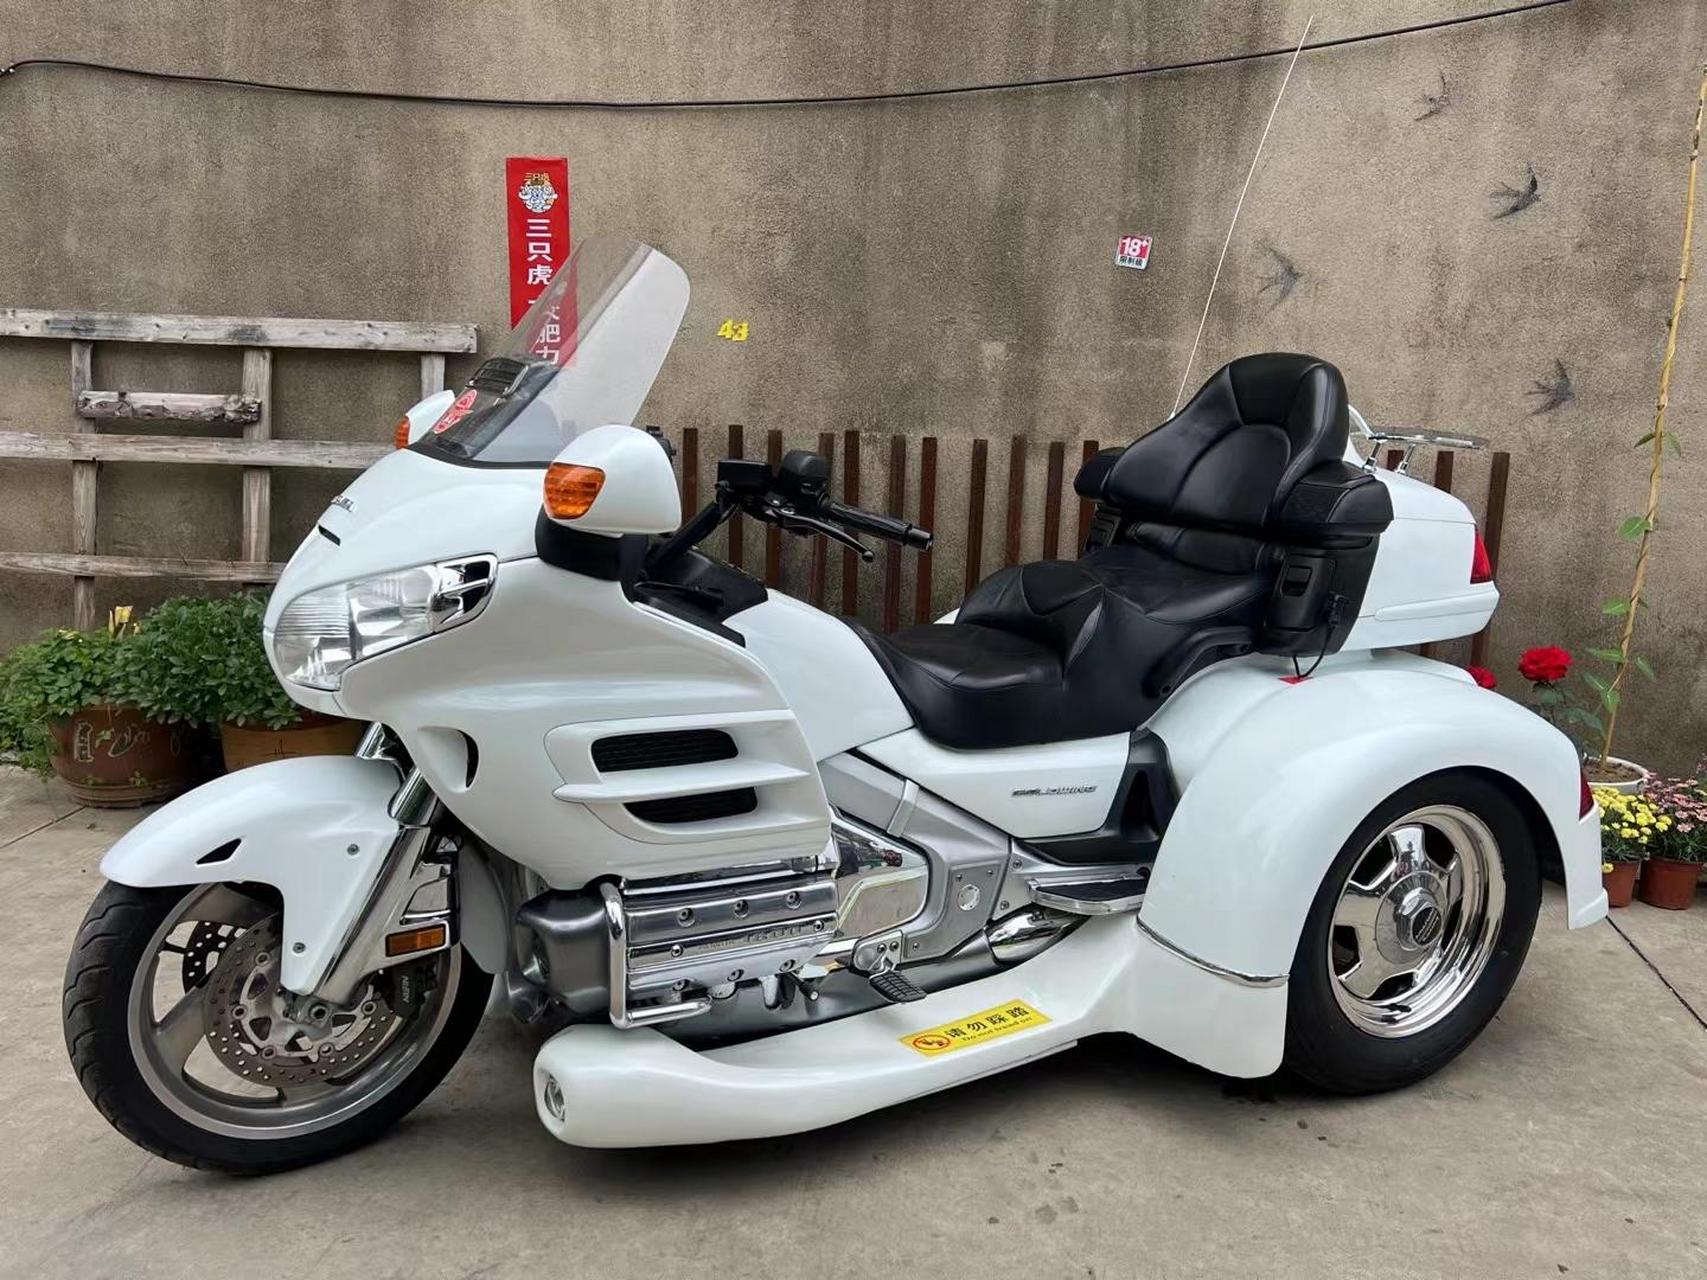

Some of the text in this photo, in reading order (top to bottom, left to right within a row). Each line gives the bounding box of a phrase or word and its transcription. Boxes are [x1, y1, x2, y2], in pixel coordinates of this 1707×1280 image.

[526, 218, 553, 286] 三只虎
[1120, 237, 1149, 256] 18+
[717, 318, 749, 341] 43
[944, 1006, 1030, 1038] 请勿踩踏
